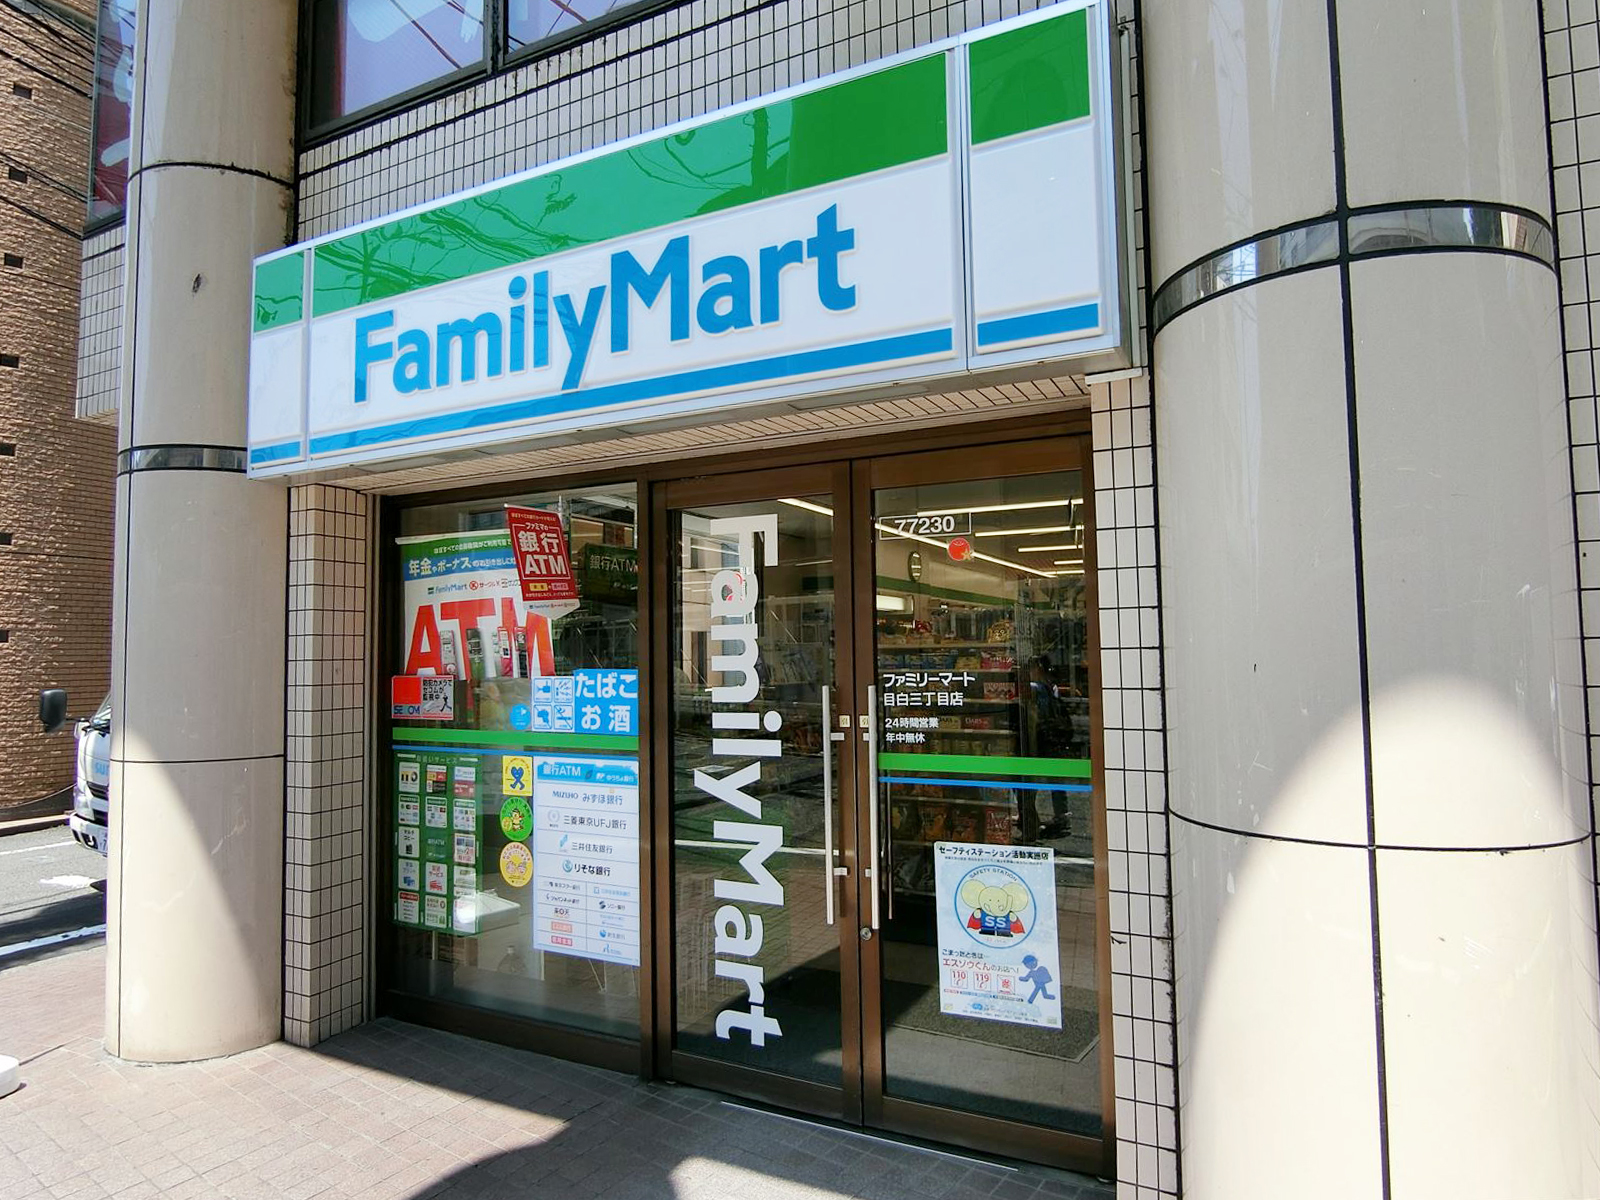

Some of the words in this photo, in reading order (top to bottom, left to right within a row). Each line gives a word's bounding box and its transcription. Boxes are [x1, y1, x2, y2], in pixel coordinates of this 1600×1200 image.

[354, 203, 856, 403] FamilyMart
[894, 516, 955, 534] 77230
[518, 531, 560, 553] 銀行
[525, 554, 567, 575] ATM
[404, 597, 556, 681] ATM
[576, 672, 638, 699] たばこ
[883, 672, 975, 687] ファミリーマート
[883, 692, 964, 707] 目白三丁目店
[393, 705, 420, 715] SEOM
[581, 704, 631, 732] お酒
[885, 717, 939, 729] 24時間営業
[885, 732, 926, 743] 年中無休
[543, 764, 581, 776] 銀行ATM
[694, 514, 785, 1047] FamilyMart
[552, 790, 579, 799] MIZUHO
[582, 793, 623, 805] みずほ銀行
[564, 815, 627, 829] 三菱東京UFJ銀行
[572, 842, 613, 854] 三井住友銀行
[574, 863, 611, 876] りそな銀行
[969, 868, 990, 878] SAFETY
[993, 868, 1018, 881] STATION
[985, 916, 1007, 927] SS
[952, 971, 966, 980] 110
